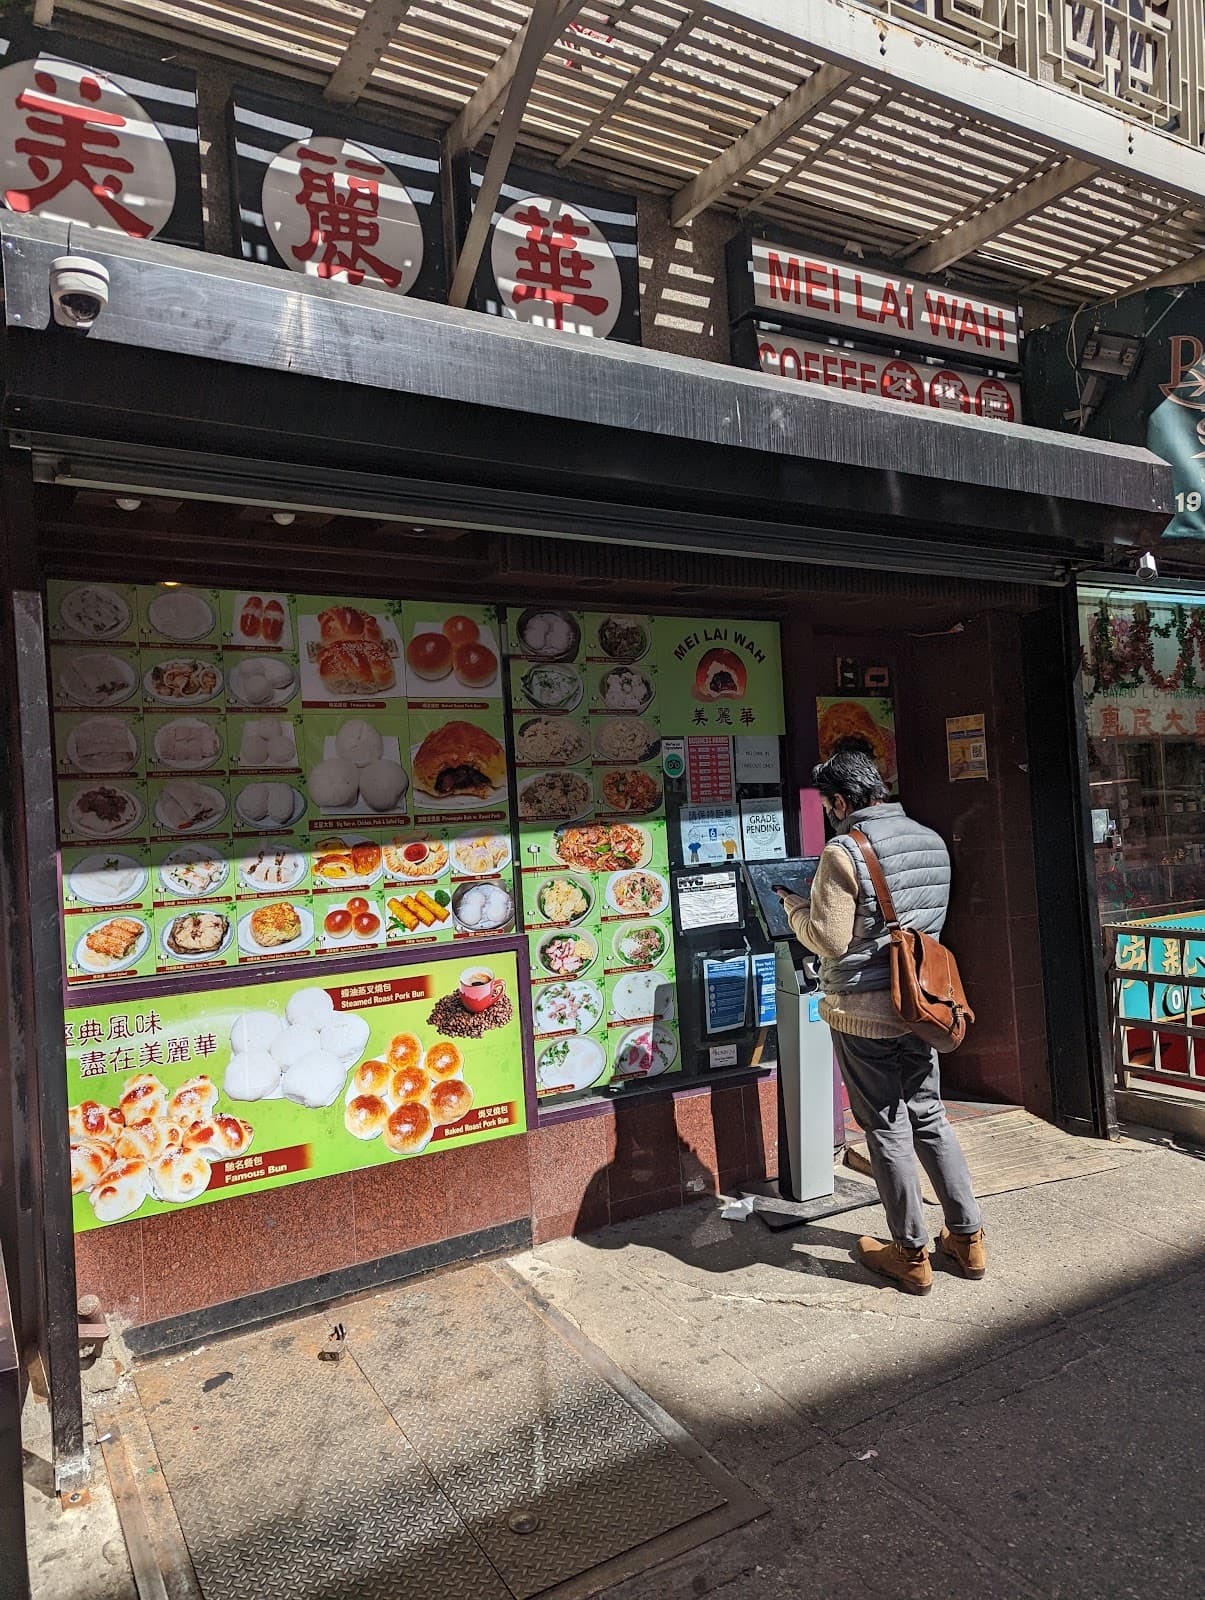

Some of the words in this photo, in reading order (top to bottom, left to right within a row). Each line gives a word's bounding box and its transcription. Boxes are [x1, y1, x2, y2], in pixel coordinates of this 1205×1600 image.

[768, 252, 841, 314] MEI
[855, 274, 915, 331] LAI
[924, 289, 1007, 352] WAH
[673, 632, 700, 661] MEI
[703, 628, 729, 642] LAI
[733, 631, 767, 664] WAH
[745, 823, 781, 835] PENDING
[749, 814, 777, 825] GRADE
[341, 997, 372, 1009] Steamed
[373, 994, 394, 1005] Roast
[394, 992, 410, 1002] Pork
[411, 990, 425, 1000] Bun
[79, 1033, 217, 1078] 盡在美麗華
[444, 1126, 464, 1137] Baked
[464, 1122, 482, 1133] Roast
[483, 1119, 498, 1130] Pork
[498, 1116, 509, 1126] Bun
[225, 1168, 265, 1184] Famous
[267, 1164, 288, 1174] Bun
